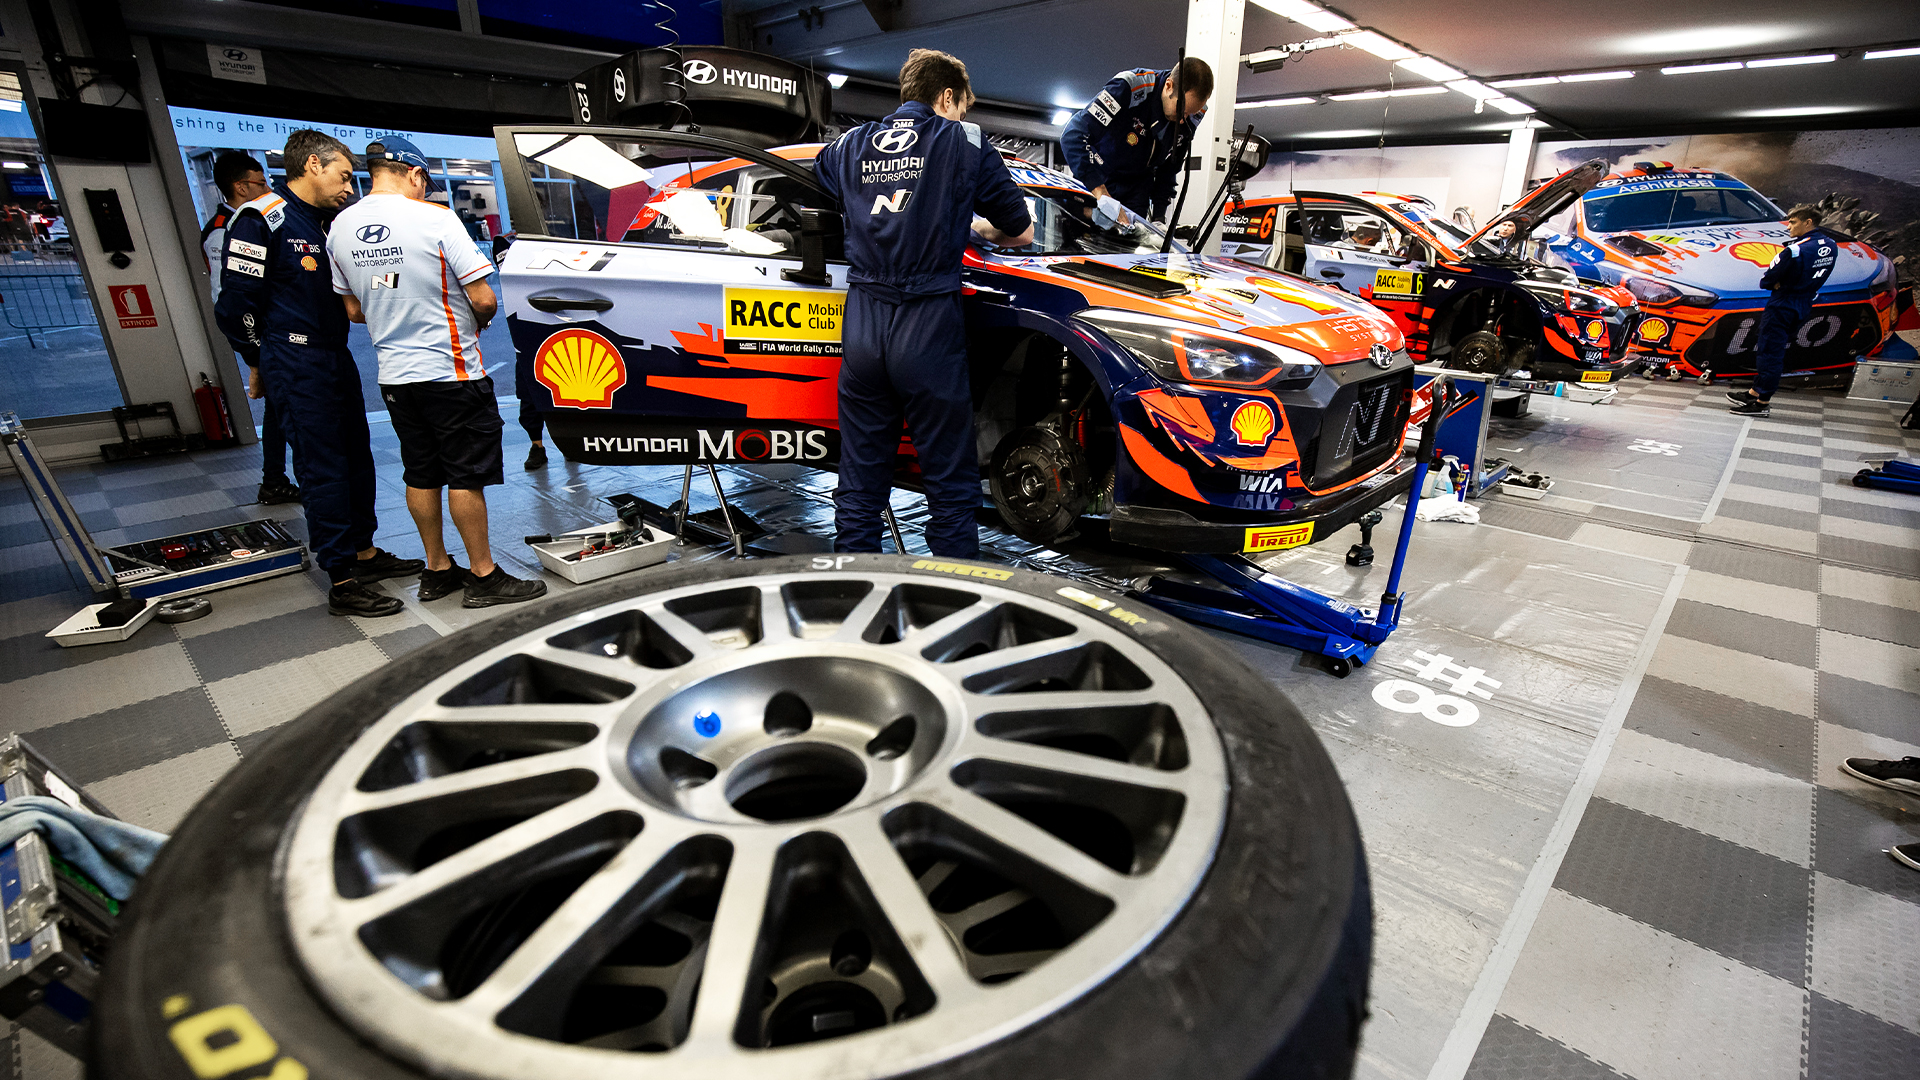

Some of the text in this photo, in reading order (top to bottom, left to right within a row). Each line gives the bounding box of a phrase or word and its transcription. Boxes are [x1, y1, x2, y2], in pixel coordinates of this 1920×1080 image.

[723, 68, 797, 95] HYUNDAI
[574, 82, 591, 123] i20
[238, 120, 264, 133] the
[333, 126, 356, 138] for
[893, 121, 914, 129] OMP
[862, 157, 925, 173] HYUNDAI
[861, 169, 923, 184] MOTORSPORT
[1259, 206, 1277, 239] 6
[1675, 226, 1748, 236] HYUNDAI
[238, 246, 262, 258] MOBIS
[293, 243, 321, 254] MOBIS
[351, 246, 403, 259] HYUNDAI
[354, 257, 404, 268] MOTORSPORT
[238, 264, 261, 276] WIA
[1376, 275, 1396, 288] RACC
[1416, 273, 1424, 295] 6
[730, 299, 845, 329] RACC Mobil
[121, 319, 157, 328] EXTINTOR
[808, 317, 836, 330] Club
[288, 334, 308, 344] OMP
[762, 343, 776, 352] FIA
[777, 343, 801, 352] World
[802, 344, 823, 355] Rally
[583, 428, 829, 461] HYUNDAI MOBIS
[1239, 473, 1283, 493] WIA
[1250, 527, 1310, 548] PIRELLI
[811, 555, 856, 570] SP
